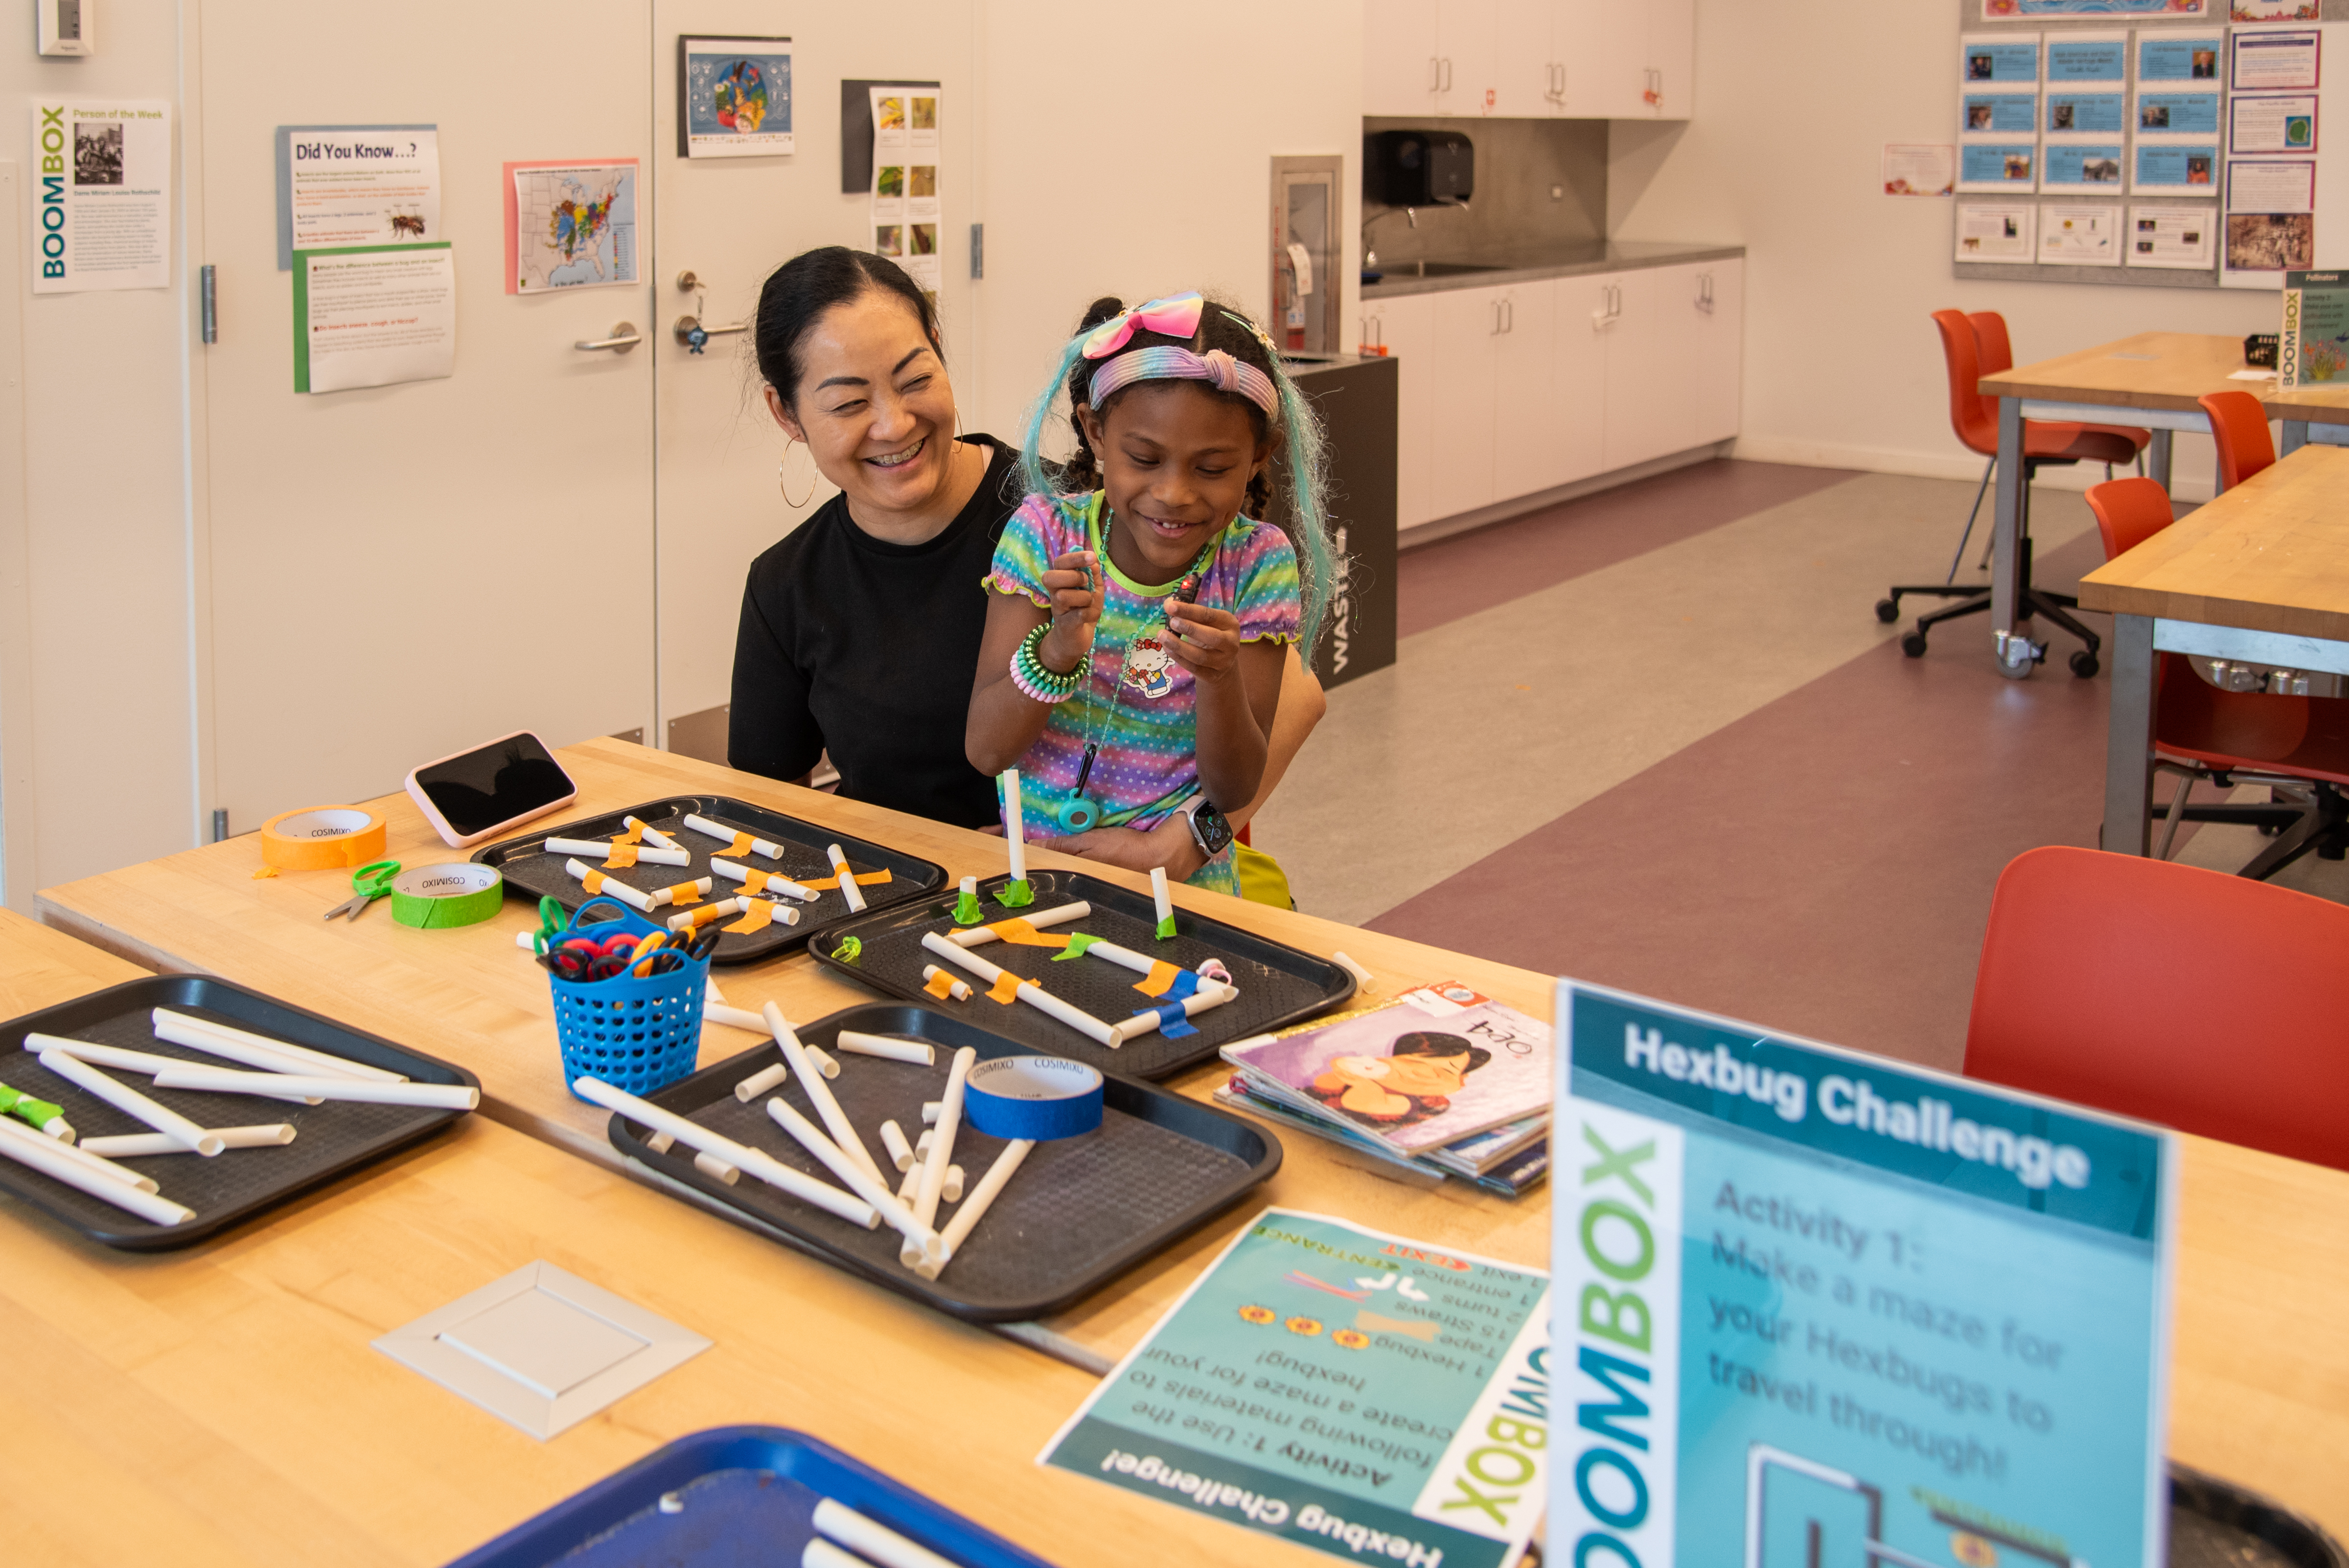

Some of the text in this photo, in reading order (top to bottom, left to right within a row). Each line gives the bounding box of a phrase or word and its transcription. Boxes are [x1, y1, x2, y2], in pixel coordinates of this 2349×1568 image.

[73, 110, 162, 119] Person of the Week
[297, 143, 321, 160] Did
[323, 143, 351, 160] You
[42, 106, 66, 278] BOOMBOX
[2283, 292, 2299, 386] BOOMBOX
[422, 876, 465, 888] COSIMIXO
[973, 1058, 1014, 1080] COSIMIXO
[1035, 1058, 1083, 1075] COSIMIXO
[1624, 1022, 2091, 1189] Hexbug Challenge
[1250, 1224, 1388, 1269] ENTRANCE
[1715, 1180, 1923, 1272] Activity 1:
[1379, 1243, 1451, 1268] EXIT
[1481, 1266, 1540, 1289] 1 exit
[1411, 1266, 1529, 1306] 1 entrance
[1441, 1293, 1523, 1324] 2 turns
[1712, 1230, 2063, 1367] Make a maze for
[1394, 1300, 1506, 1341] 15 Straws
[1374, 1335, 1485, 1380] 1 Hexbug
[1439, 1334, 1497, 1360] Tape
[1708, 1295, 2053, 1435] your Hexbugs to
[1254, 1349, 1367, 1392] hexbug!
[1144, 1346, 1453, 1442] create a maze for your
[1708, 1351, 2007, 1480] travel through!
[1128, 1370, 1432, 1469] following materials to
[1131, 1400, 1392, 1487] Activity 1: Use the
[1101, 1448, 1443, 1568] Hexbug Challenge!
